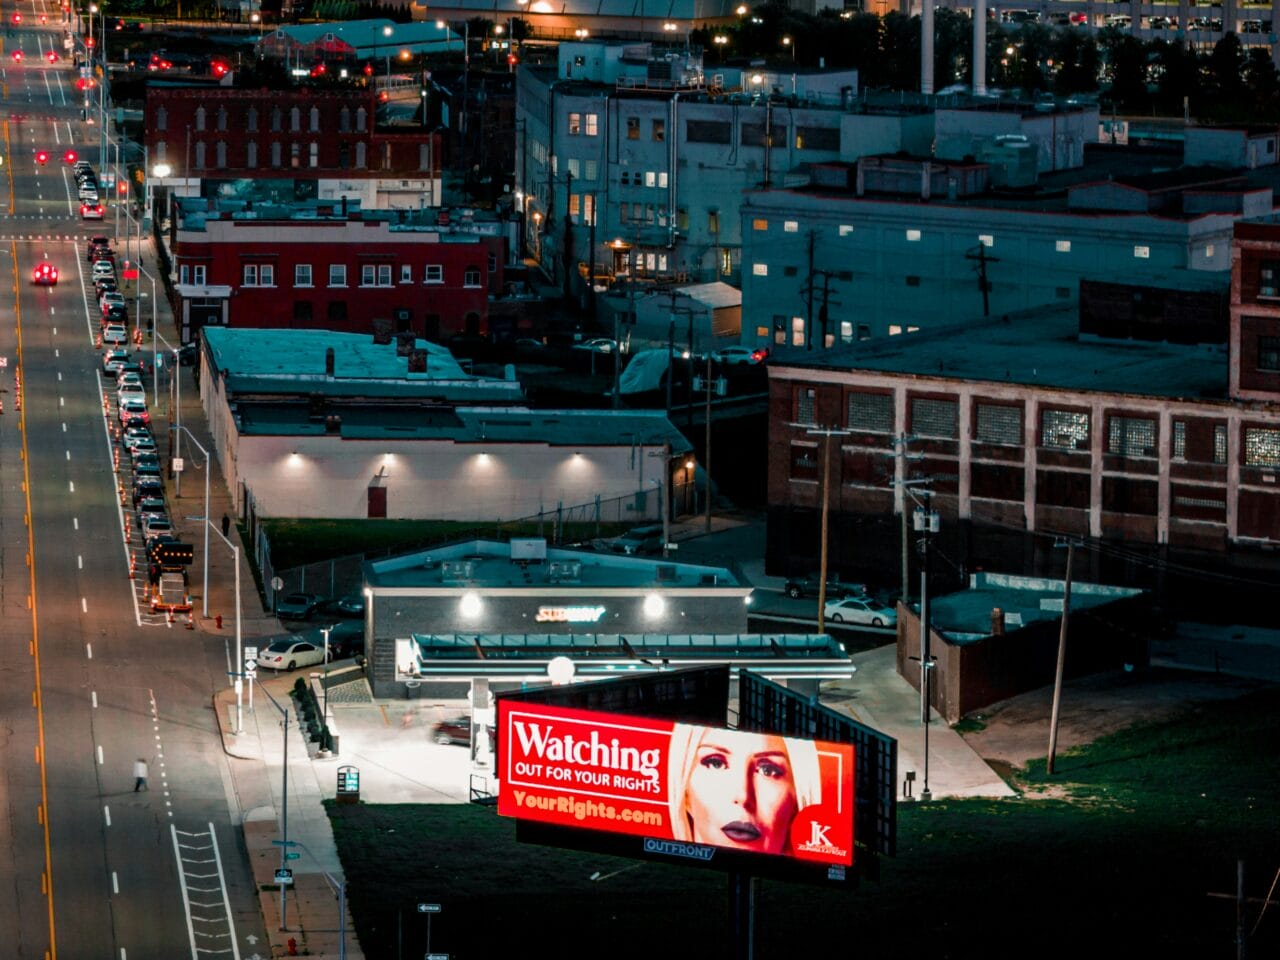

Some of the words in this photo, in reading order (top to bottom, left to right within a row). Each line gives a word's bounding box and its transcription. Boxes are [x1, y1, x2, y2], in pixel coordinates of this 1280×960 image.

[513, 721, 661, 785] Watching
[515, 762, 543, 777] OUT
[546, 766, 571, 781] FOR
[574, 770, 610, 786] YOUR
[613, 775, 661, 794] RIGHTS
[513, 790, 663, 826] YourRights.com
[646, 839, 711, 858] OUTFRONT
